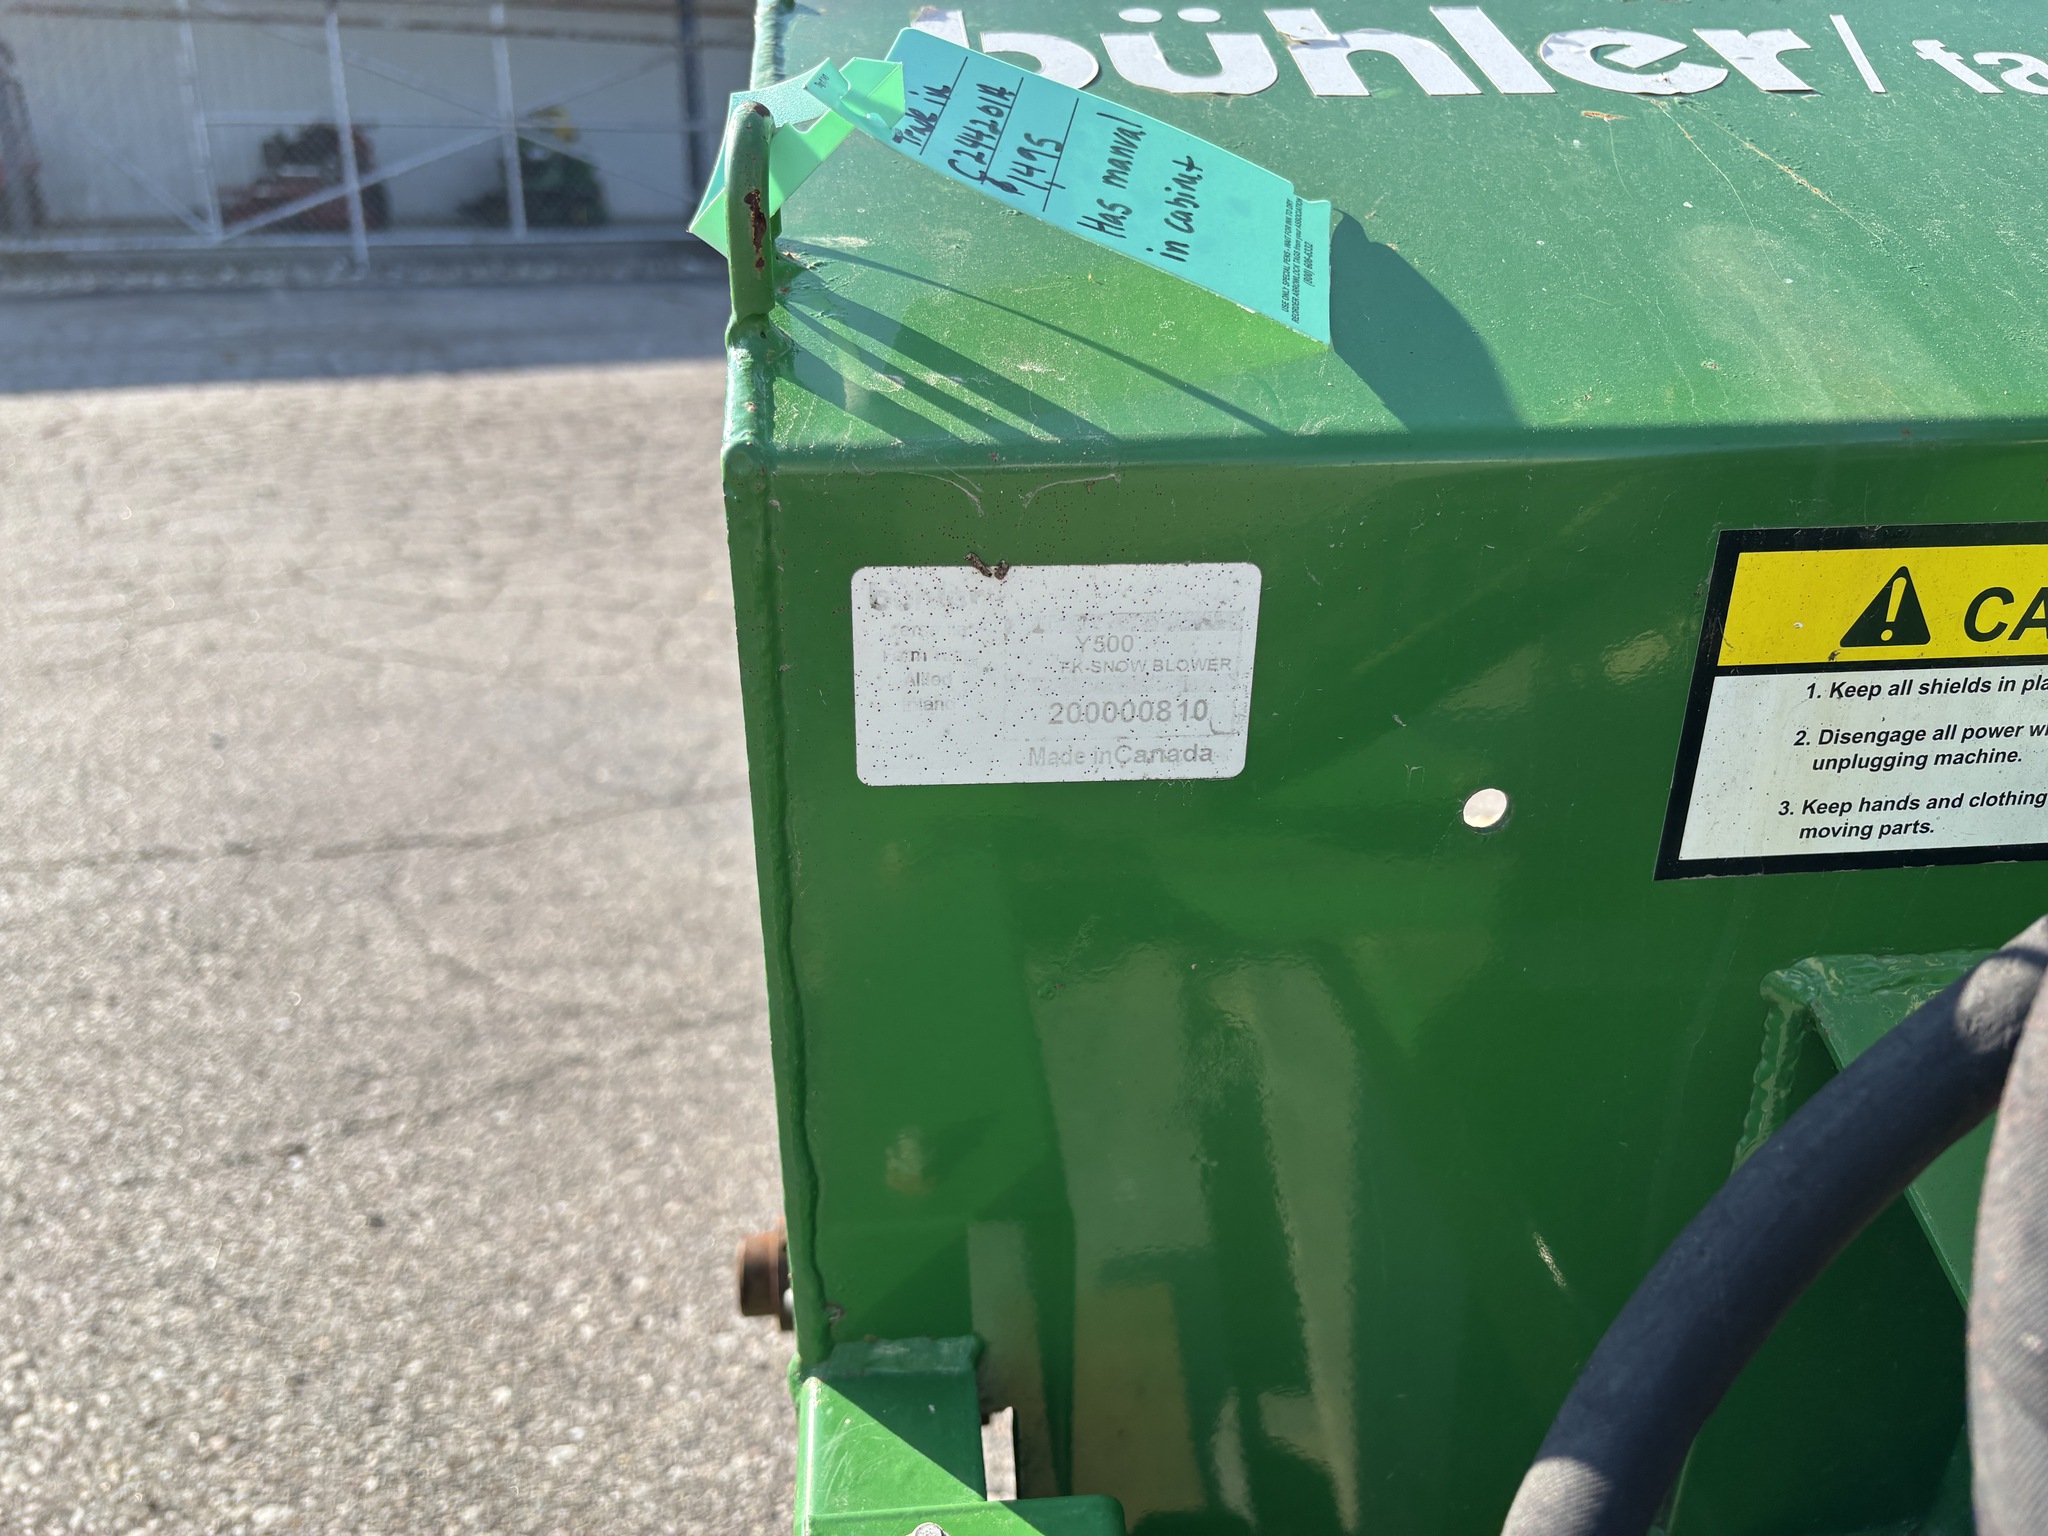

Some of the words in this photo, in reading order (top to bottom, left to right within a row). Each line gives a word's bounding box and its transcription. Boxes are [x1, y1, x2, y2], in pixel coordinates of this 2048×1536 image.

[908, 85, 951, 106] in
[1076, 198, 1133, 239] Has
[1284, 224, 1292, 236] FOR
[1145, 240, 1190, 263] in
[1283, 234, 1292, 248] WAIT
[1282, 250, 1291, 265] PENS
[1292, 249, 1301, 264] TAGS
[1282, 264, 1290, 287] SPECIAL
[1281, 286, 1290, 300] ONLY
[1281, 299, 1290, 313] USE
[1291, 296, 1300, 324] REORDER
[1075, 634, 1135, 653] Y500
[1152, 658, 1232, 673] BLOWER
[1806, 682, 1822, 699] 1.
[1829, 681, 1882, 700] Keep
[1887, 679, 1914, 696] all
[1918, 677, 1992, 695] shields
[1997, 676, 2016, 692] in
[1048, 699, 1209, 724] 200000810
[1793, 730, 1811, 746] 2.
[1817, 726, 1927, 746] Disengage
[1932, 724, 1958, 741] all
[1961, 724, 2025, 743] power
[1029, 747, 1086, 767] Made
[1811, 752, 1929, 773] unplugging
[1933, 748, 2023, 766] machine.
[1778, 800, 1795, 816] 3.
[1801, 798, 1853, 817] Keep
[1858, 794, 1920, 812] hands
[1926, 793, 1965, 810] and
[1968, 789, 2048, 809] clothing
[1798, 822, 1874, 840] moving
[1877, 819, 1935, 840] parts.
